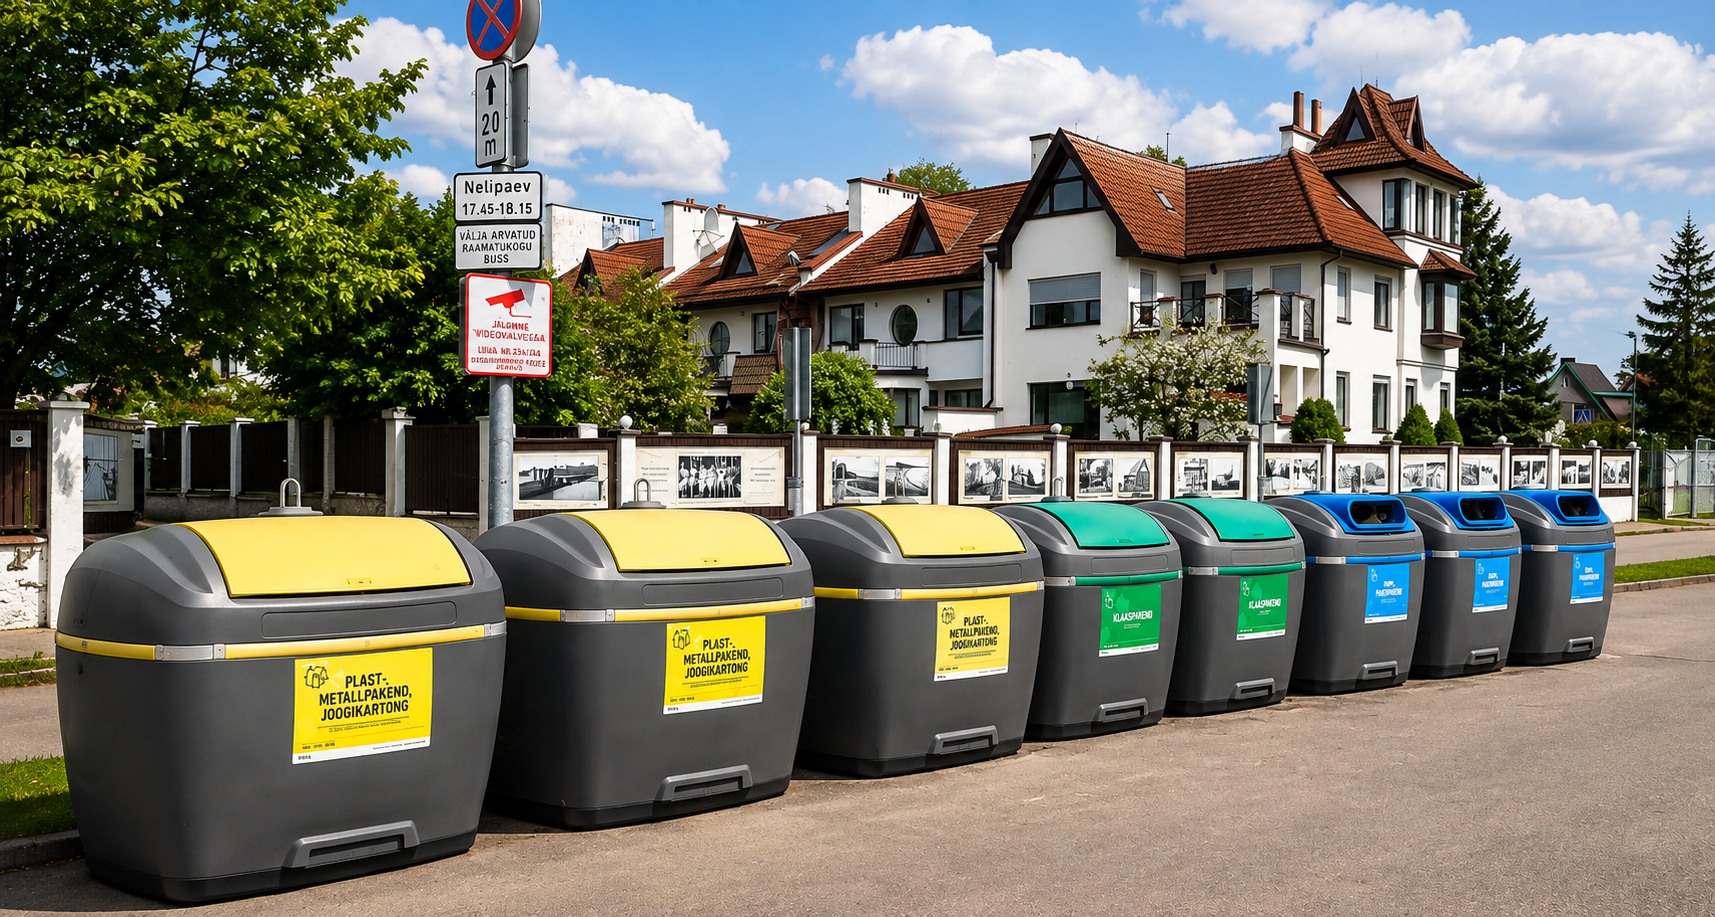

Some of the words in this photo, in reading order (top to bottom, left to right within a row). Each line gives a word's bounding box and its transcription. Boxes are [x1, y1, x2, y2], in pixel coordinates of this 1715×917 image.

[482, 111, 499, 136] 20
[485, 138, 496, 156] m
[465, 180, 531, 196] Nelipaev
[462, 202, 532, 215] 17.45-18.15
[491, 230, 536, 240] ARVATUD
[462, 242, 532, 253] RAAMATUKOGU
[484, 254, 509, 264] BUSS
[685, 662, 748, 679] JOOGIKARTONG
[319, 685, 412, 706] METALLPAKEND,
[321, 699, 409, 721] JOOGIKARTONG
